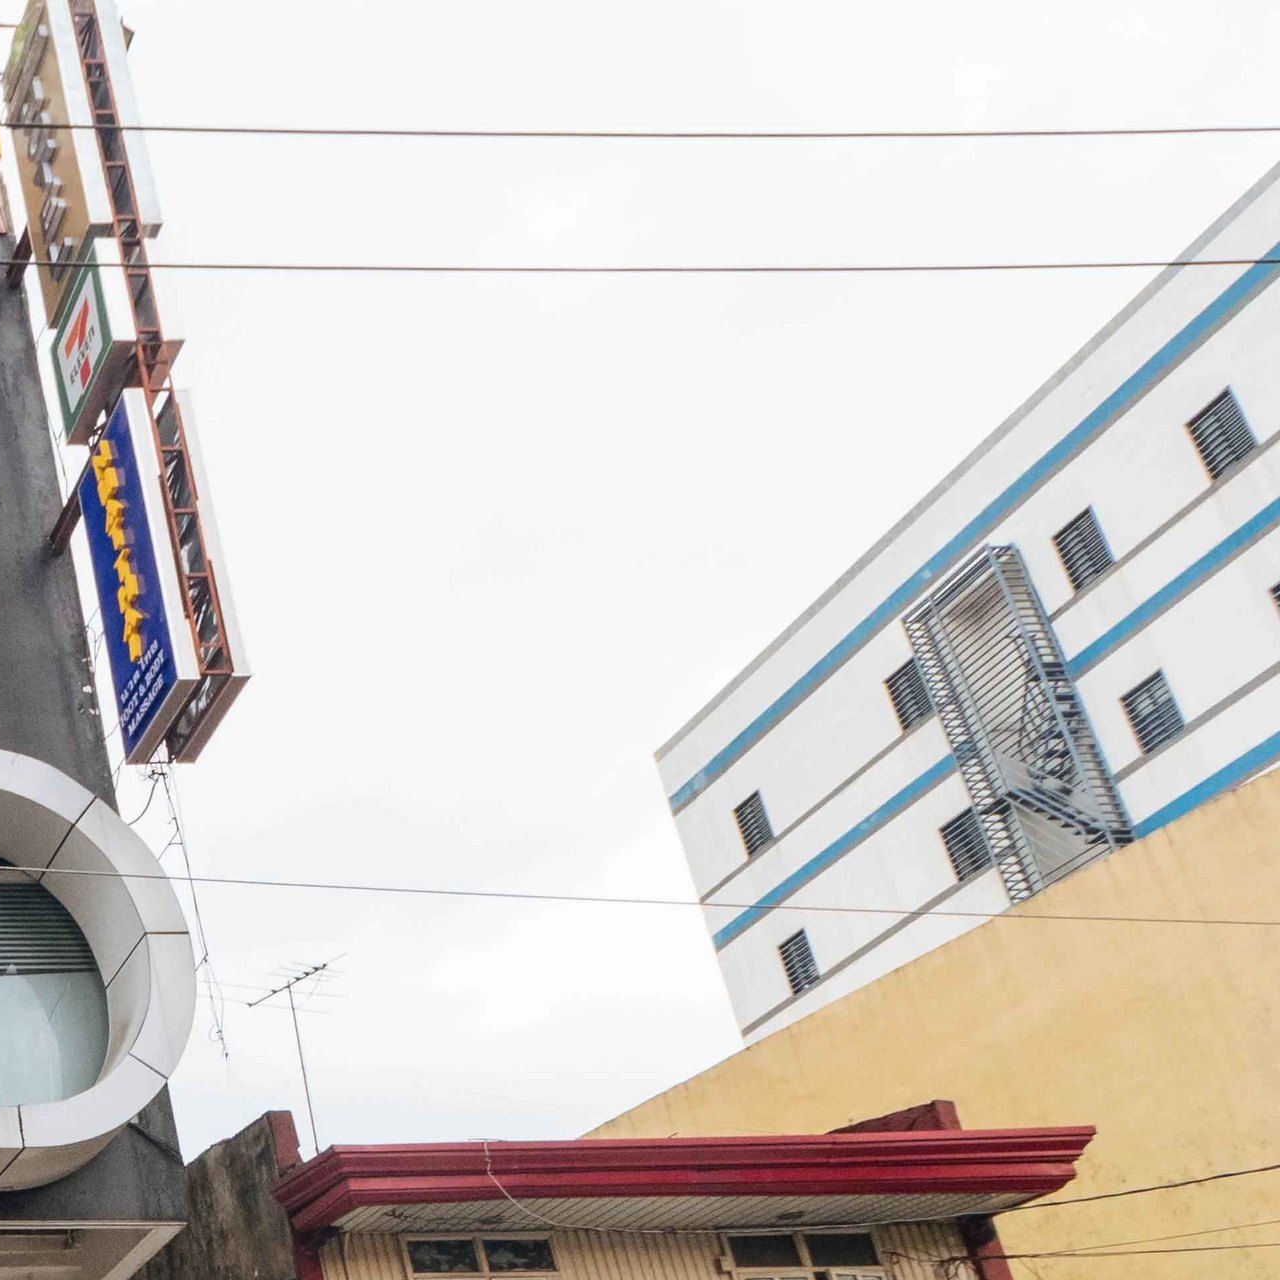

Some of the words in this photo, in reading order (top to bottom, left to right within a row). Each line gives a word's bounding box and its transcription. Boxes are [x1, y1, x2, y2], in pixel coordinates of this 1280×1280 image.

[64, 296, 92, 390] 7
[119, 691, 140, 728] FOOT
[144, 648, 165, 687] BODY
[127, 673, 164, 737] MASSAGE
